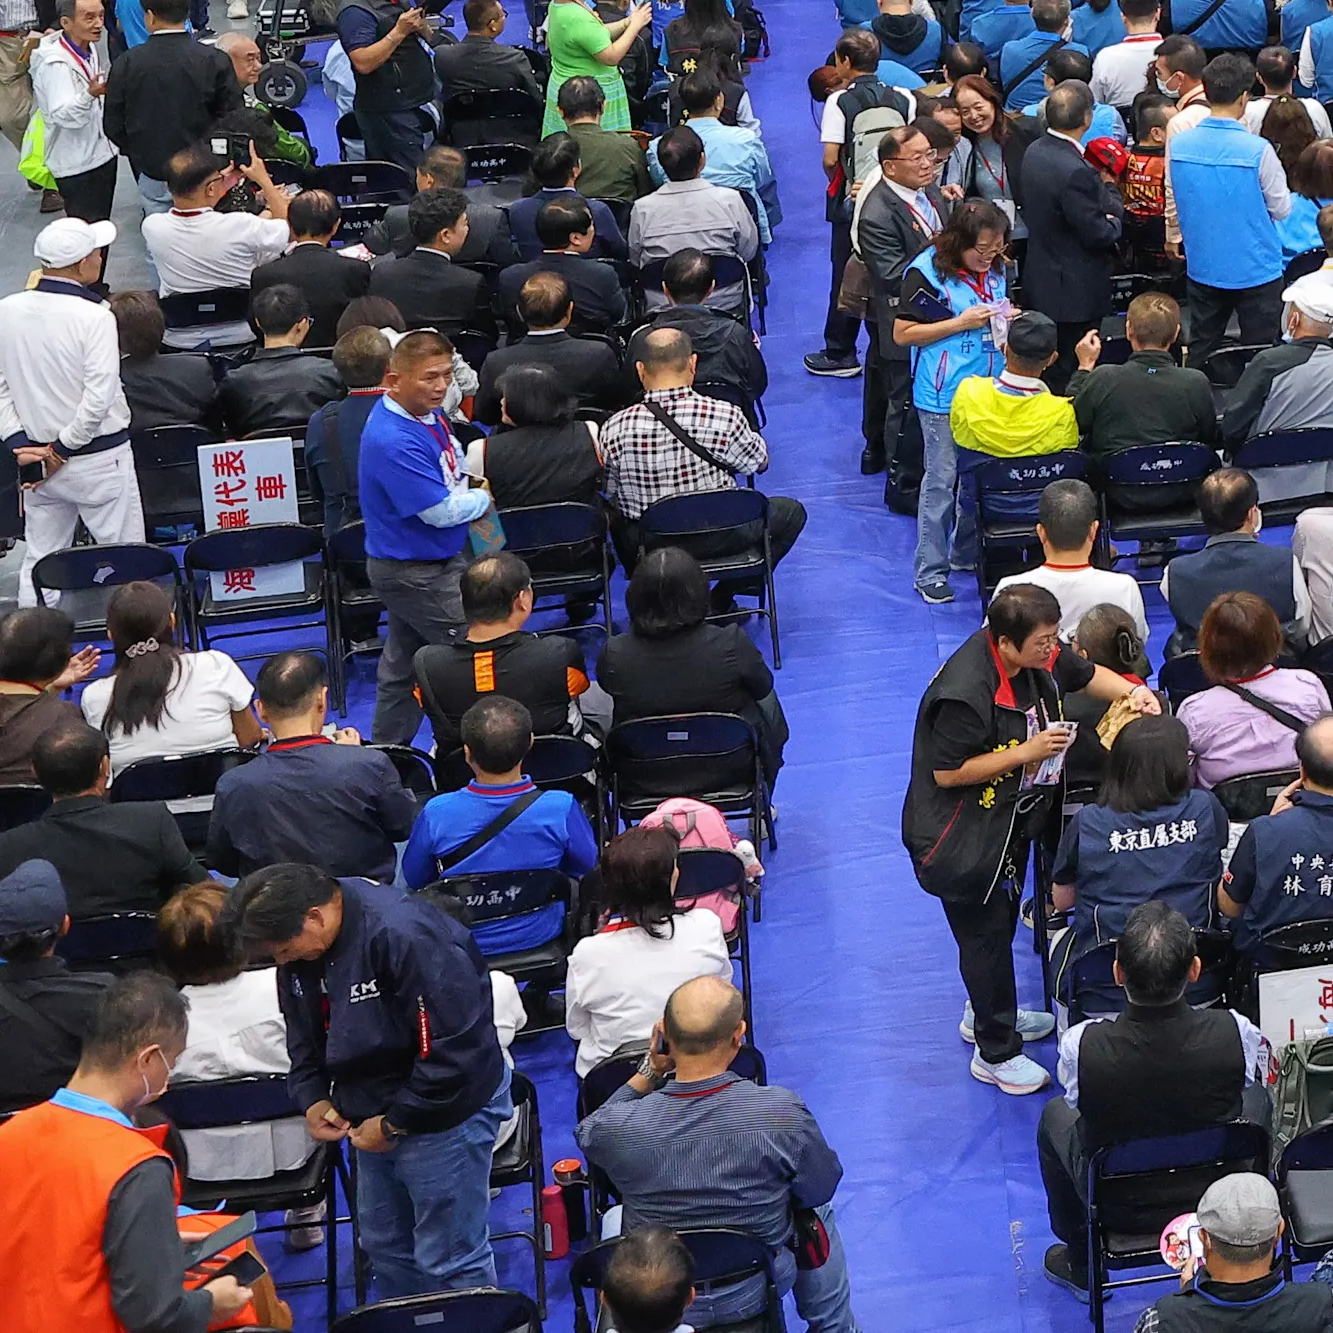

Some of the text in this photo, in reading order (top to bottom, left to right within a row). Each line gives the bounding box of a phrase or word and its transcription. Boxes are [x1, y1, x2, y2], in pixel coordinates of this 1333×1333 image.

[1009, 462, 1066, 482] 成功高中
[212, 447, 257, 594] 海黨代表
[466, 885, 523, 907] 功高中
